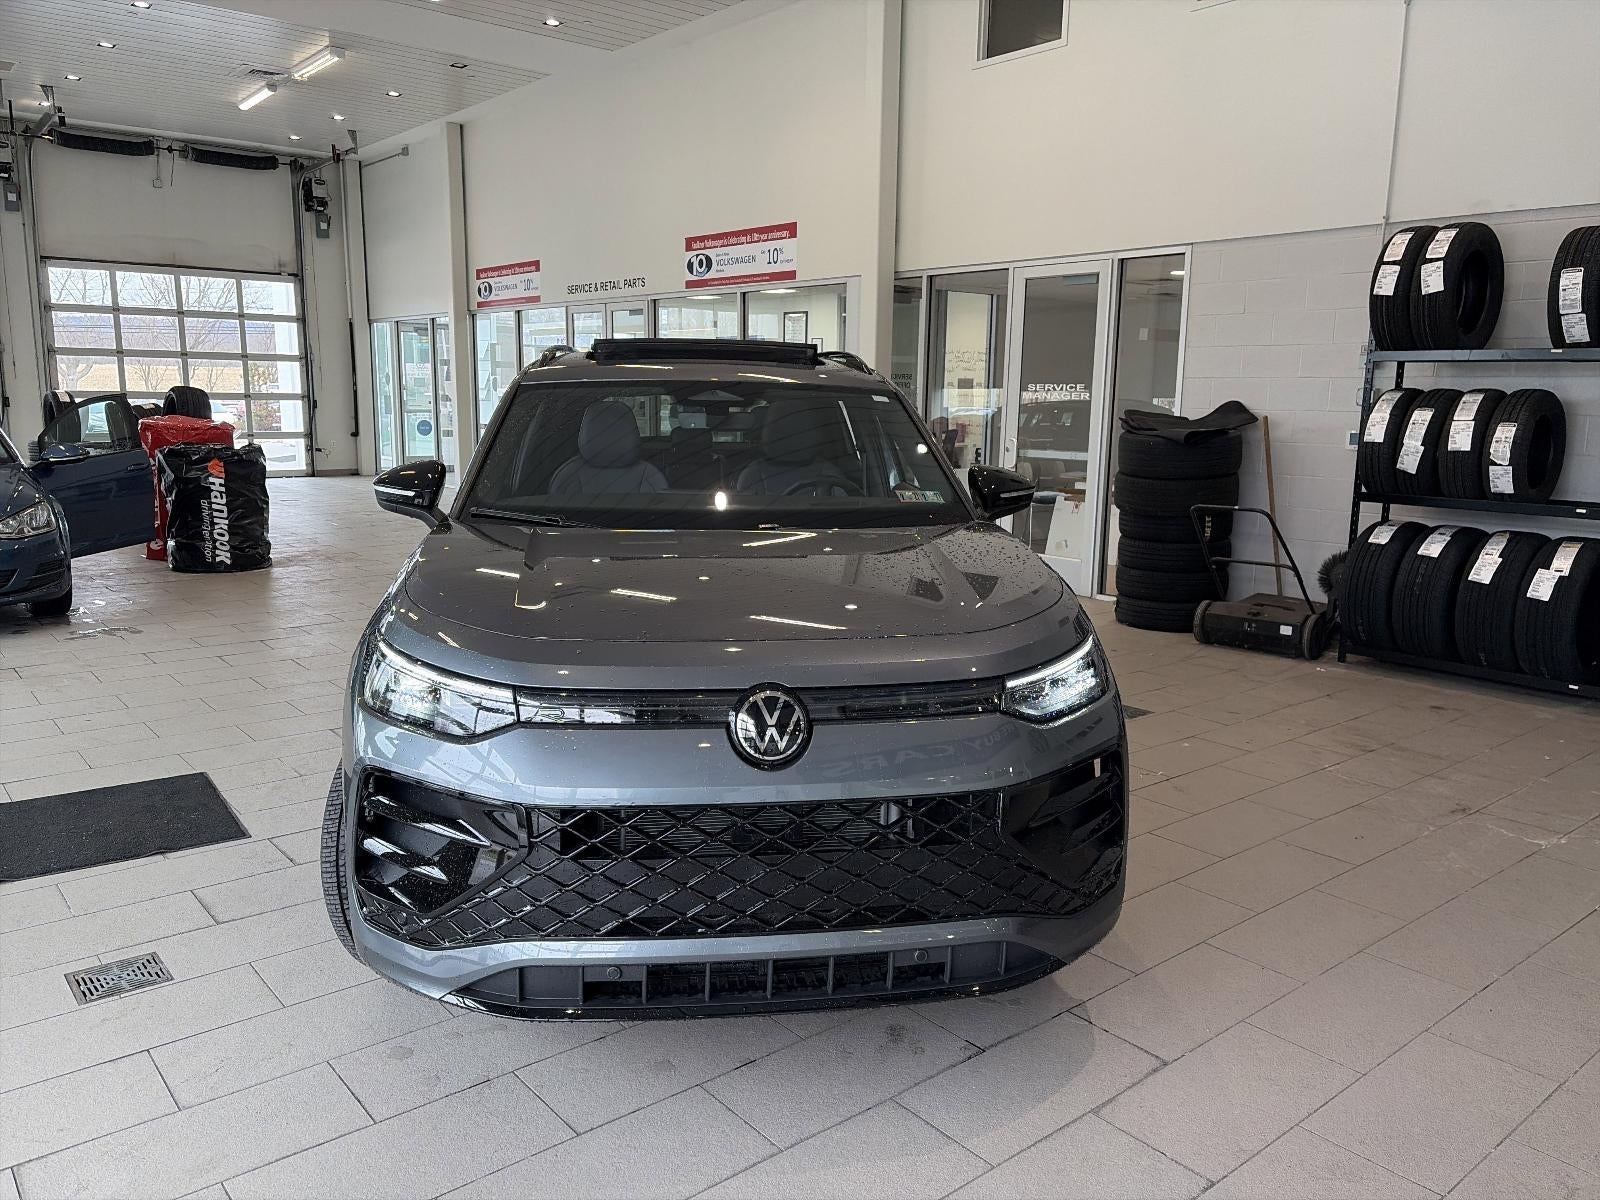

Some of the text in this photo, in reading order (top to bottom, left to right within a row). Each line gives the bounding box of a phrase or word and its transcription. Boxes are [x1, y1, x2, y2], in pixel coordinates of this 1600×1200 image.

[715, 254, 757, 267] VOLKSWAGEN
[566, 277, 646, 295] SERVICE & RETAIL PARTS
[1027, 383, 1086, 392] SERVICE
[1022, 391, 1091, 401] MANAGER
[201, 499, 212, 531] driving
